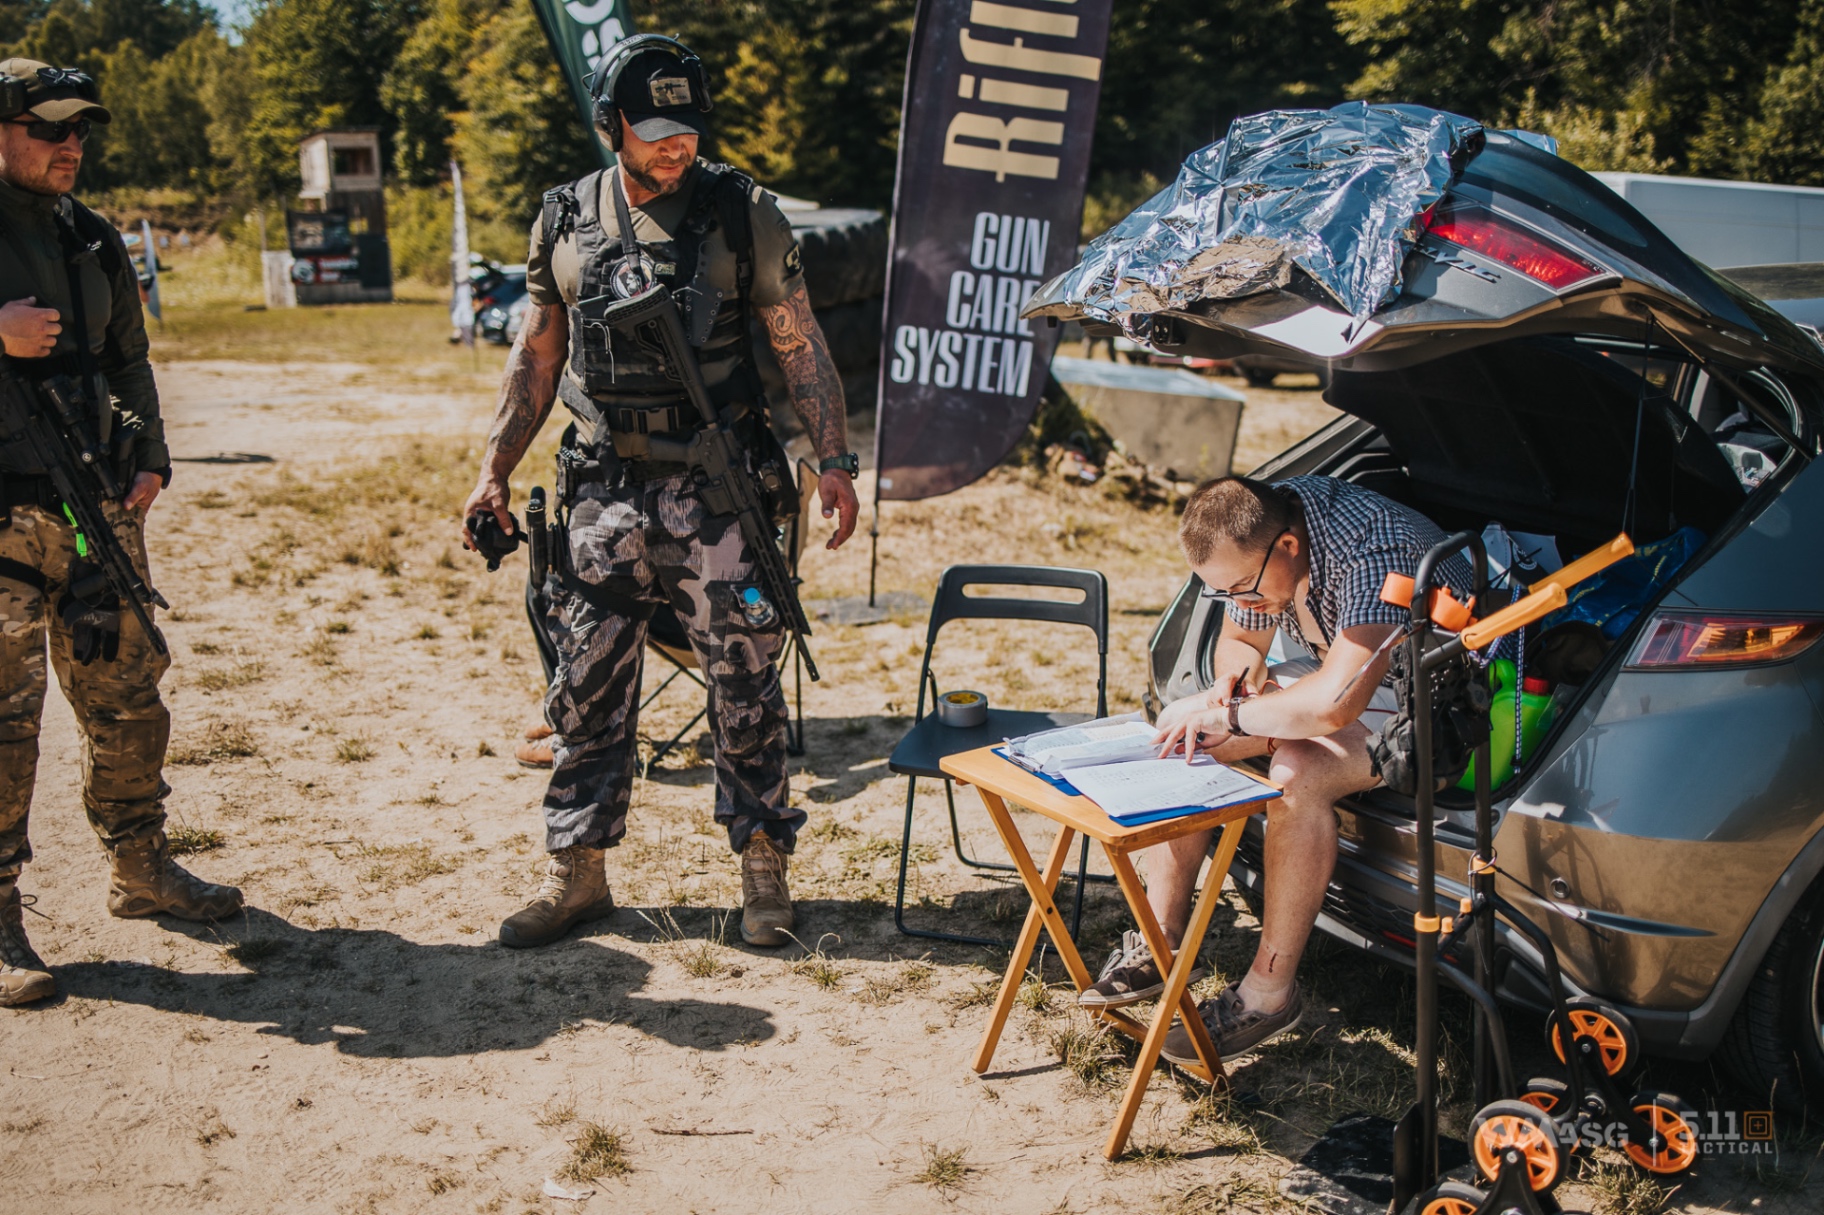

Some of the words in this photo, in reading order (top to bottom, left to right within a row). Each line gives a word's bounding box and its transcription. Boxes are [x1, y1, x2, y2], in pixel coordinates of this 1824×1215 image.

[943, 0, 1102, 183] Rifl
[970, 211, 1050, 276] GUN
[946, 270, 1042, 337] CARE
[890, 325, 1034, 398] SYSTEM
